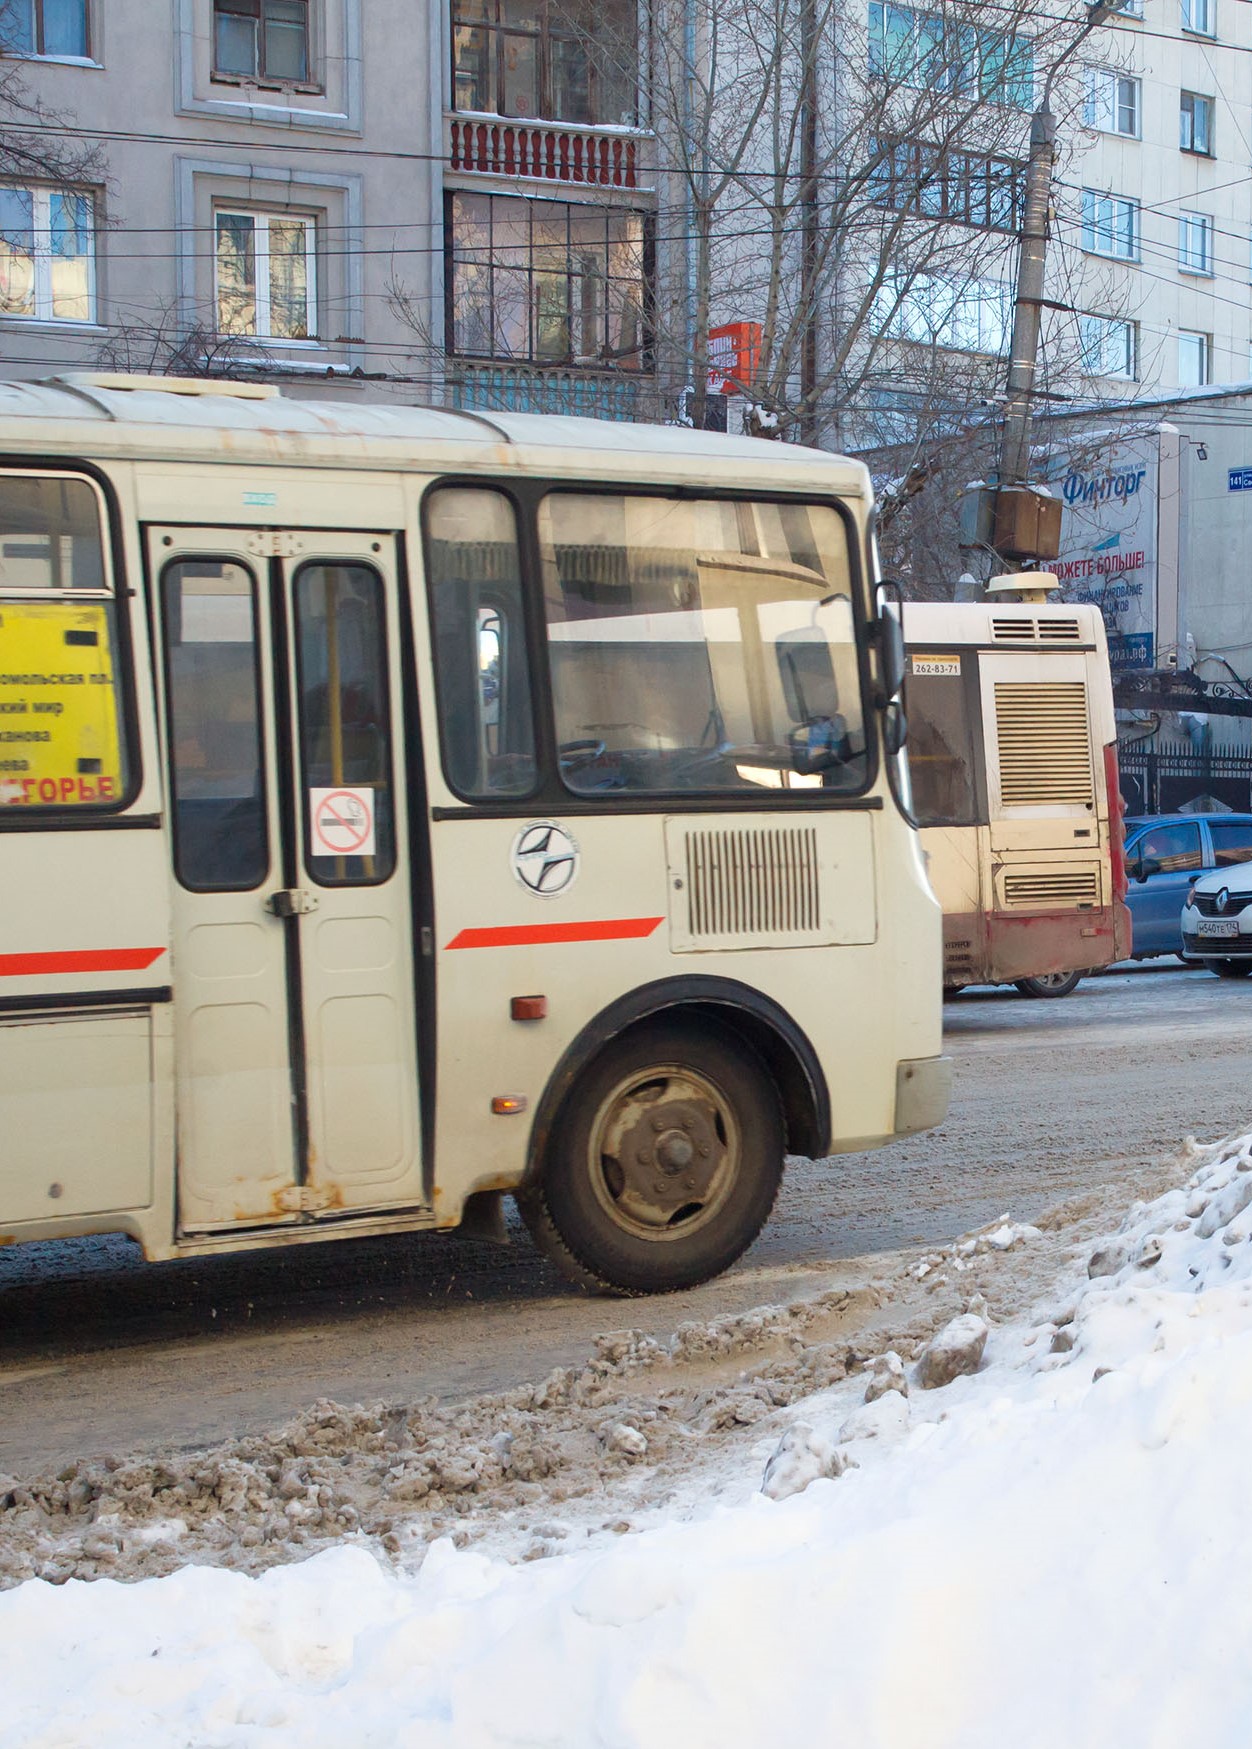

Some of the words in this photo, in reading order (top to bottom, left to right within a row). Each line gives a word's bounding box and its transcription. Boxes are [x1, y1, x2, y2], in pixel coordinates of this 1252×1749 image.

[1063, 470, 1146, 504] Финторг
[1230, 476, 1242, 486] 141
[1048, 559, 1094, 580] МОЖЕТЕ
[1097, 551, 1144, 574] БОЛЬШЕ!
[916, 664, 958, 673] 262-83-71
[33, 702, 64, 717] мир
[0, 759, 29, 771] ева
[1199, 923, 1225, 934] М540ТЕ
